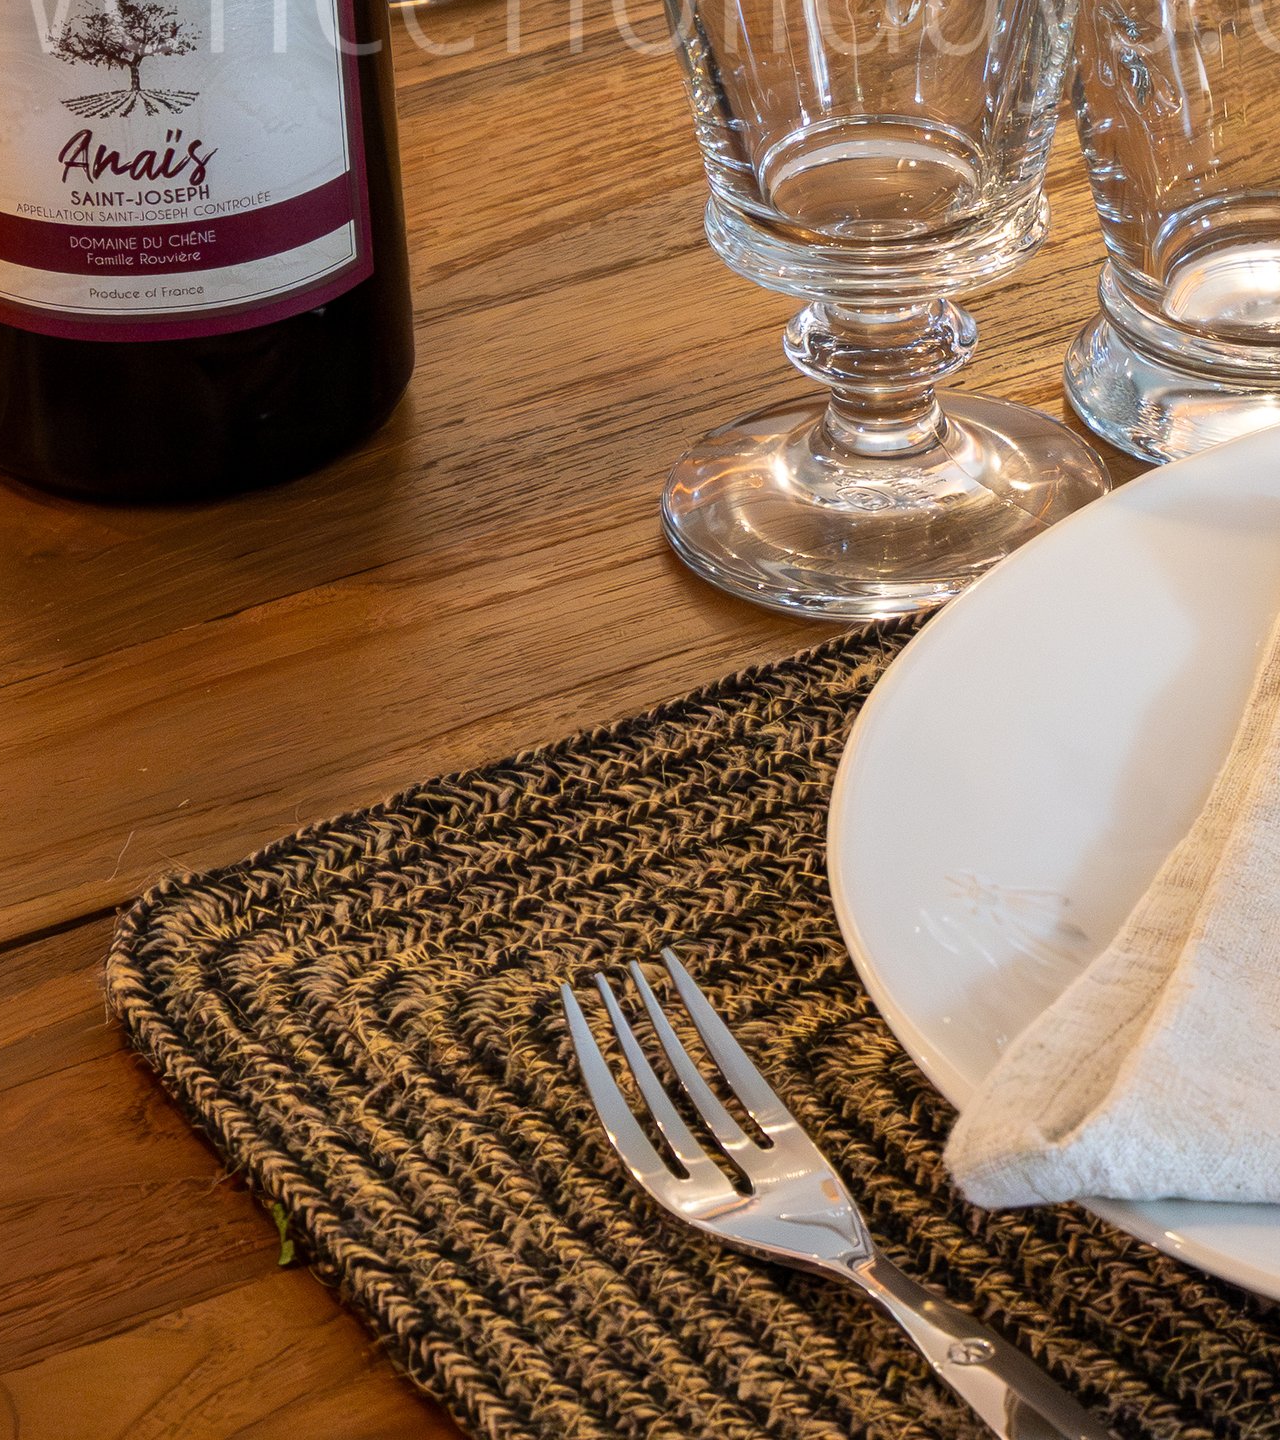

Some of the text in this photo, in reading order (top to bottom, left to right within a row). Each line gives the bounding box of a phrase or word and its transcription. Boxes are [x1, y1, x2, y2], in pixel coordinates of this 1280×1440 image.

[58, 128, 219, 186] Anaïs
[71, 184, 210, 207] SAINT-JOSEPH
[16, 203, 94, 222] APPELLATION
[99, 207, 188, 222] SAINT-JOSEPH
[70, 230, 217, 250] DOMAINE DU CHÊNE
[86, 251, 202, 266] Famille Rouvière
[89, 285, 204, 299] Produce of France
